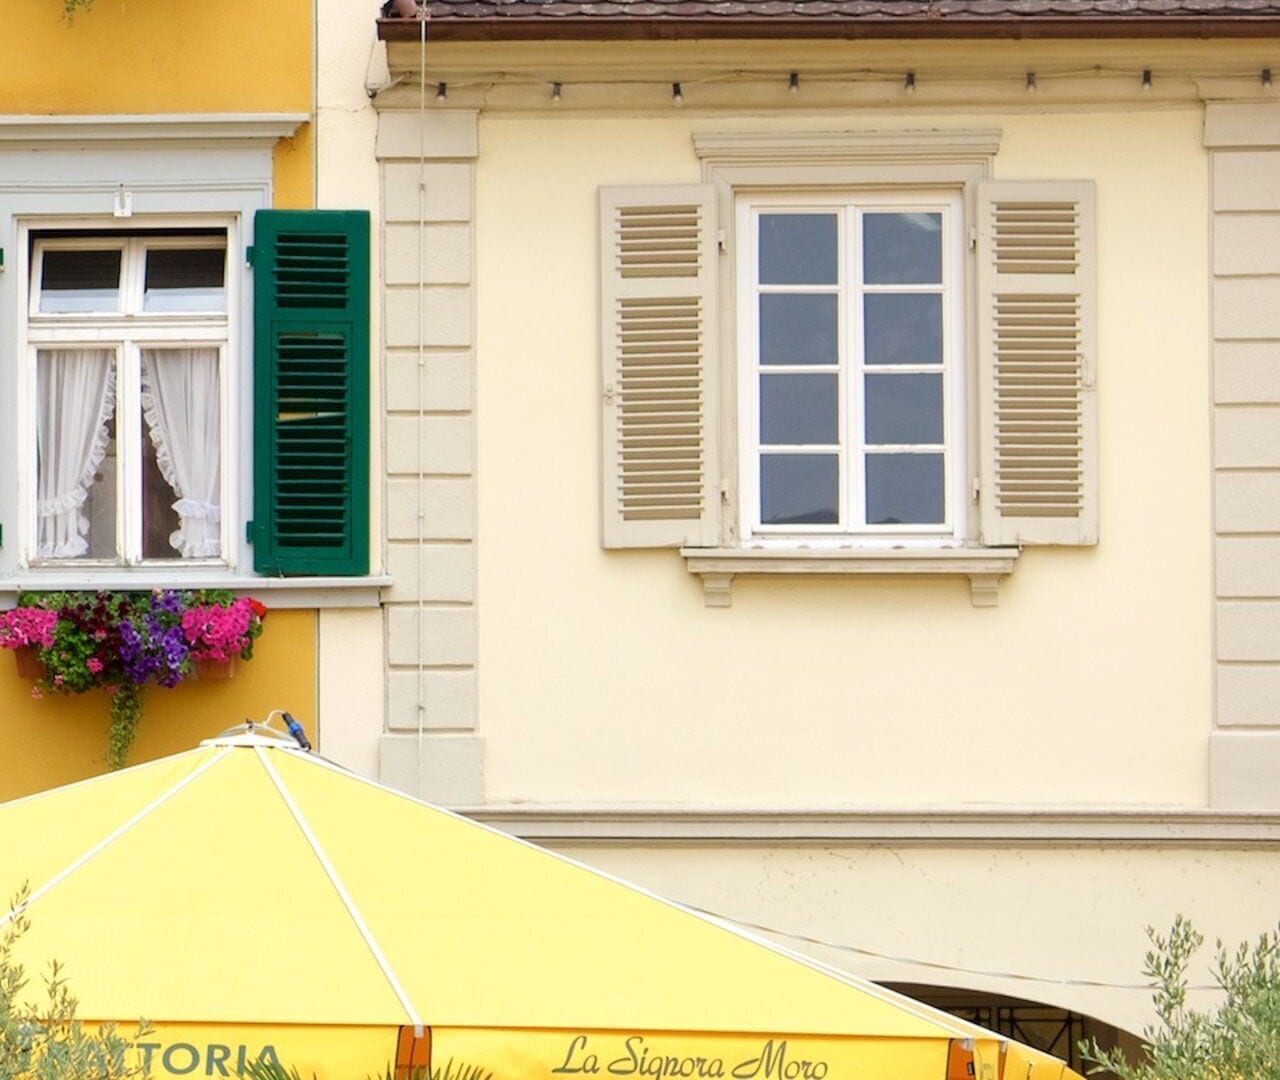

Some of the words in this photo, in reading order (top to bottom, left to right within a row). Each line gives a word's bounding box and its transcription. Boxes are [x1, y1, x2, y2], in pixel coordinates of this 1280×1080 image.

[551, 1035, 600, 1074] La
[607, 1036, 725, 1080] Signora
[731, 1039, 829, 1080] Moro
